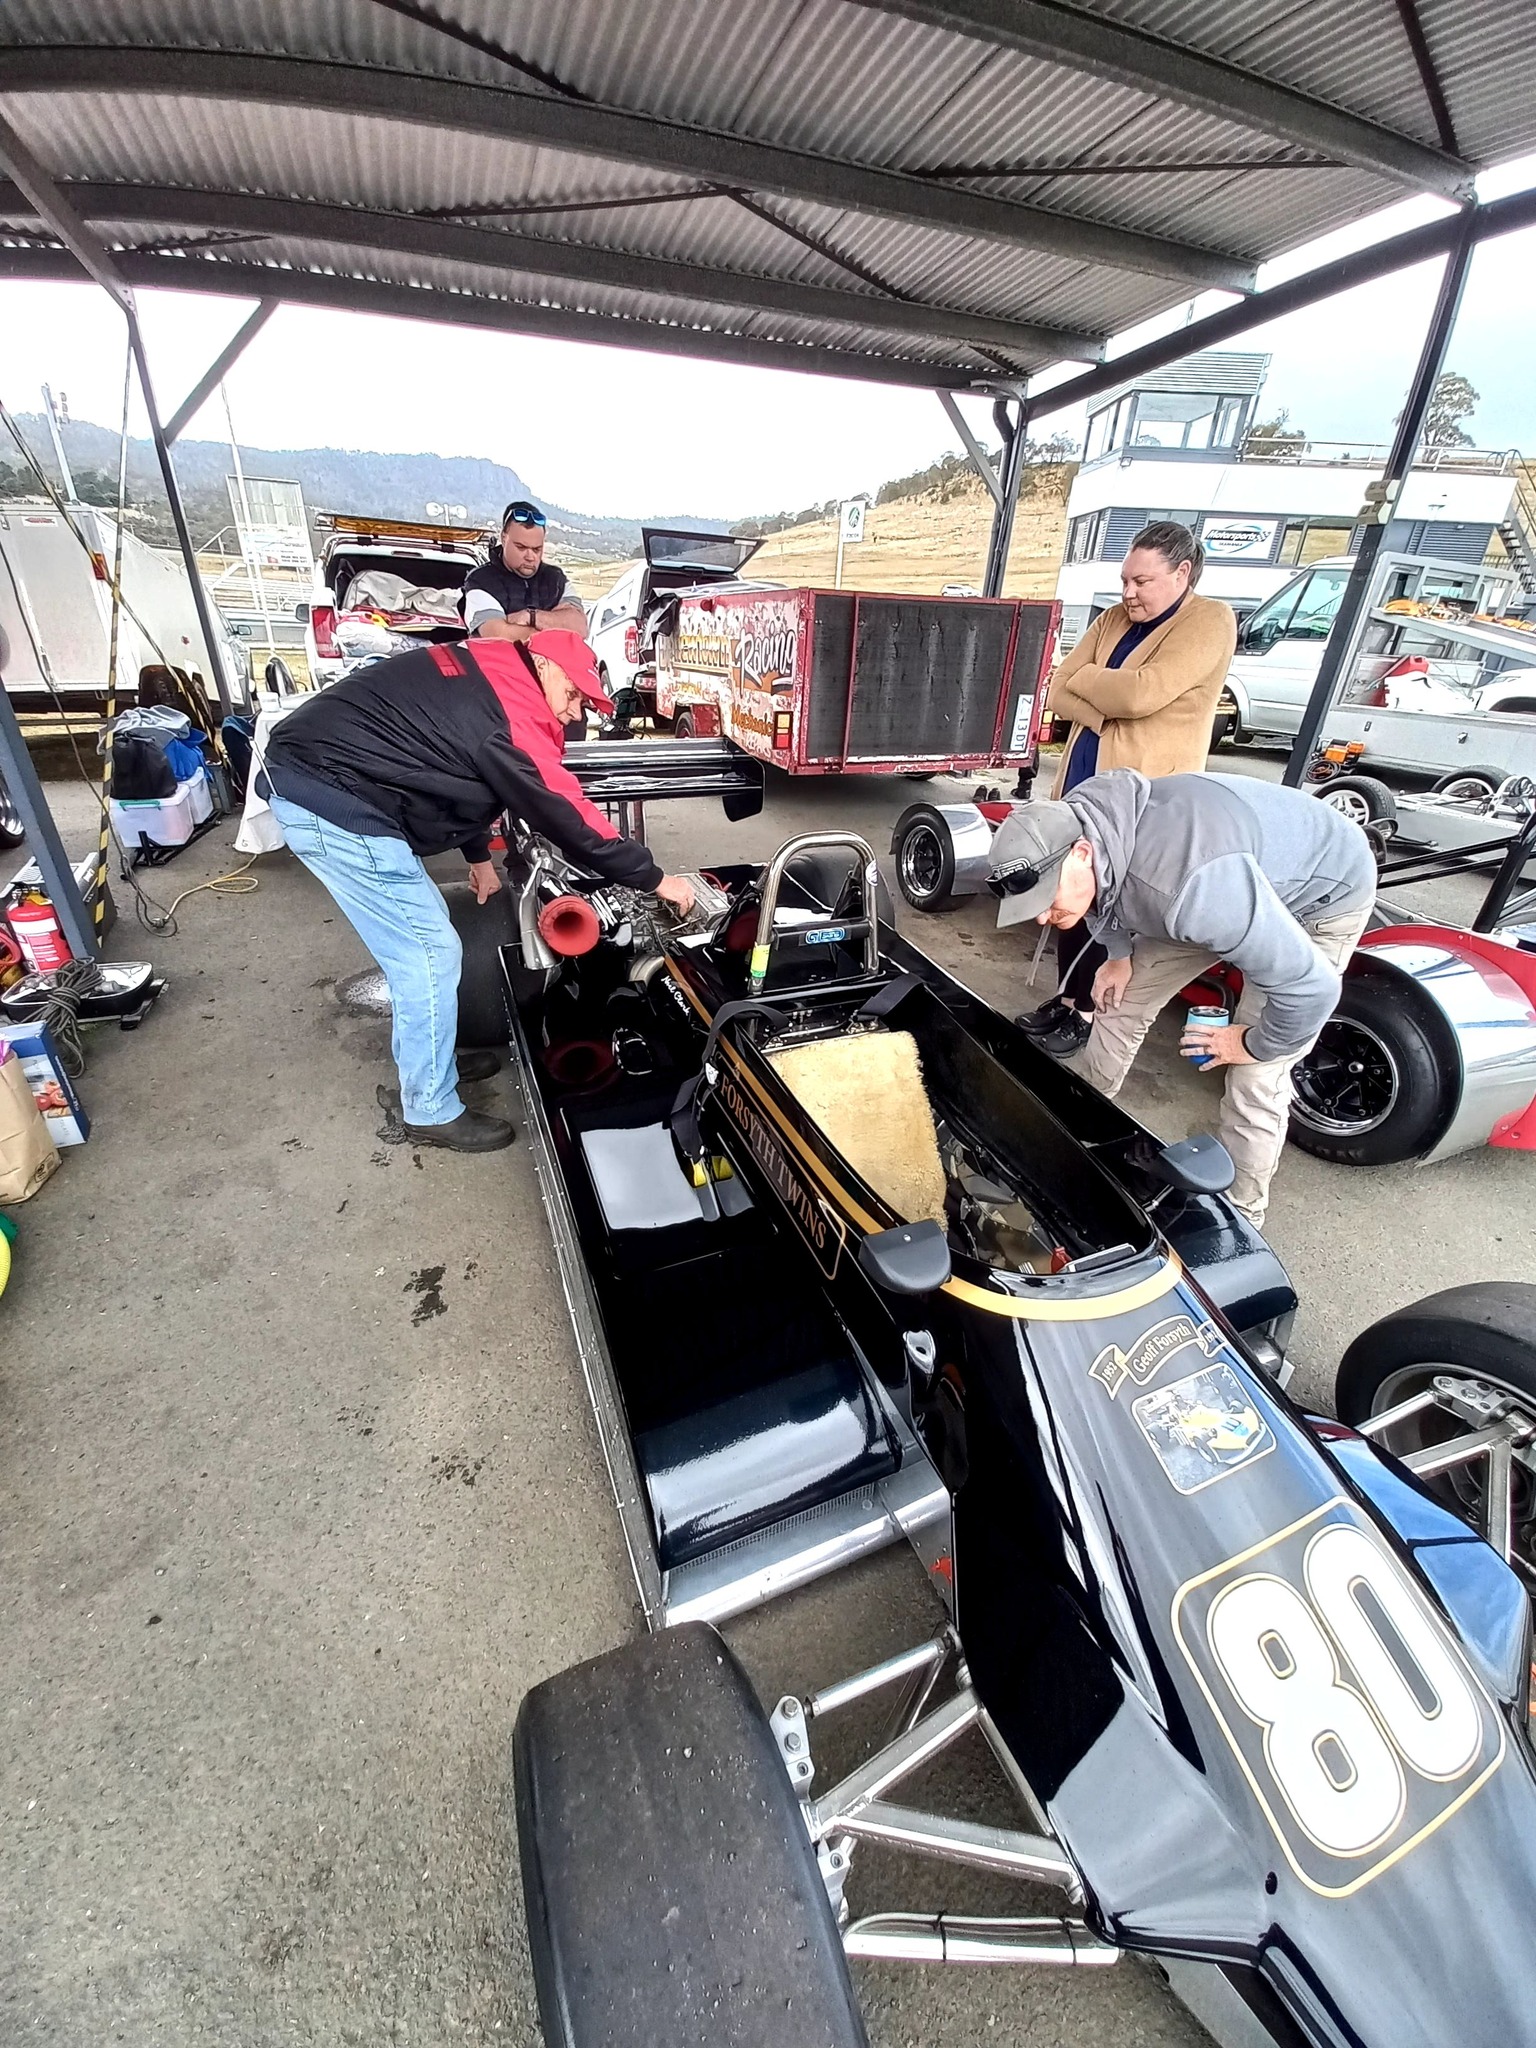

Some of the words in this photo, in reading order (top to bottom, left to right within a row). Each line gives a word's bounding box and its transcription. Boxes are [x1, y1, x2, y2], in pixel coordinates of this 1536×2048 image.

[1206, 530, 1260, 542] Motorsports
[735, 621, 797, 698] Racing
[673, 990, 691, 1017] Clark
[720, 1074, 780, 1172] FORSYTH
[776, 1157, 827, 1249] TWINS
[1101, 1360, 1118, 1381] 1952
[1132, 1341, 1160, 1373] Geoff
[1153, 1322, 1192, 1351] Forsyth
[1206, 1522, 1483, 1858] 80
